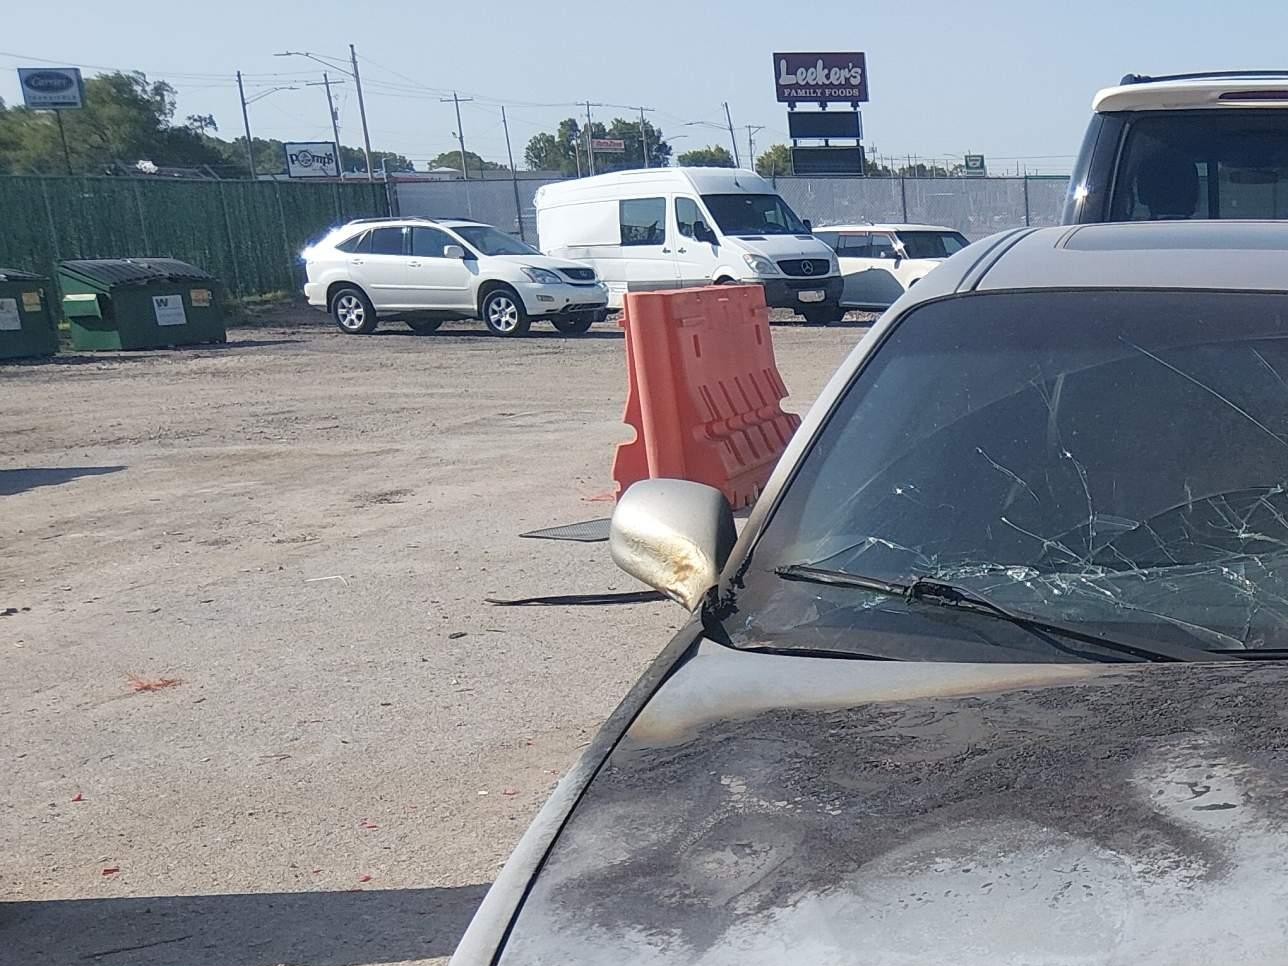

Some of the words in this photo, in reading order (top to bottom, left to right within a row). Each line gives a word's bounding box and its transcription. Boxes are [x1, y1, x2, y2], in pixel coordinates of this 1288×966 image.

[779, 59, 861, 85] Leeker's
[784, 88, 822, 97] FAMILY
[825, 88, 859, 97] FOODS
